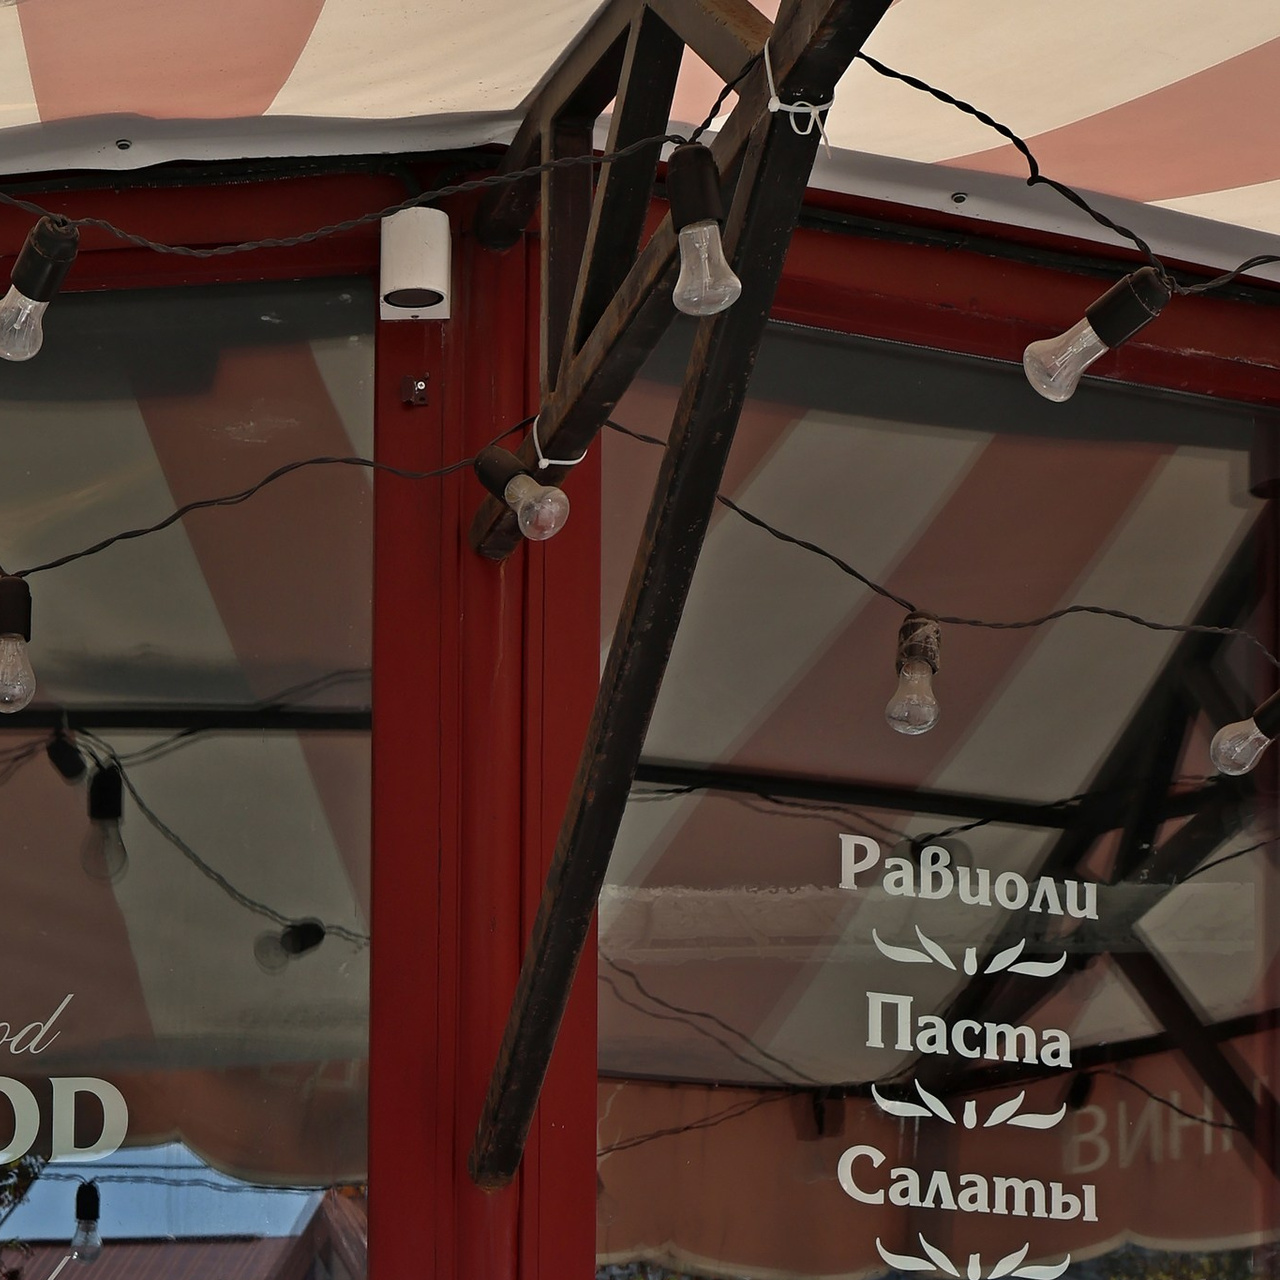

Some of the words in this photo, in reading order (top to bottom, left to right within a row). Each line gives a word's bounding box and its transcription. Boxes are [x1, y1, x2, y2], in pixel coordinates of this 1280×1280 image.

[838, 833, 1099, 920] Равиоли
[865, 992, 1072, 1068] Паста
[837, 1145, 1098, 1222] Салаты
